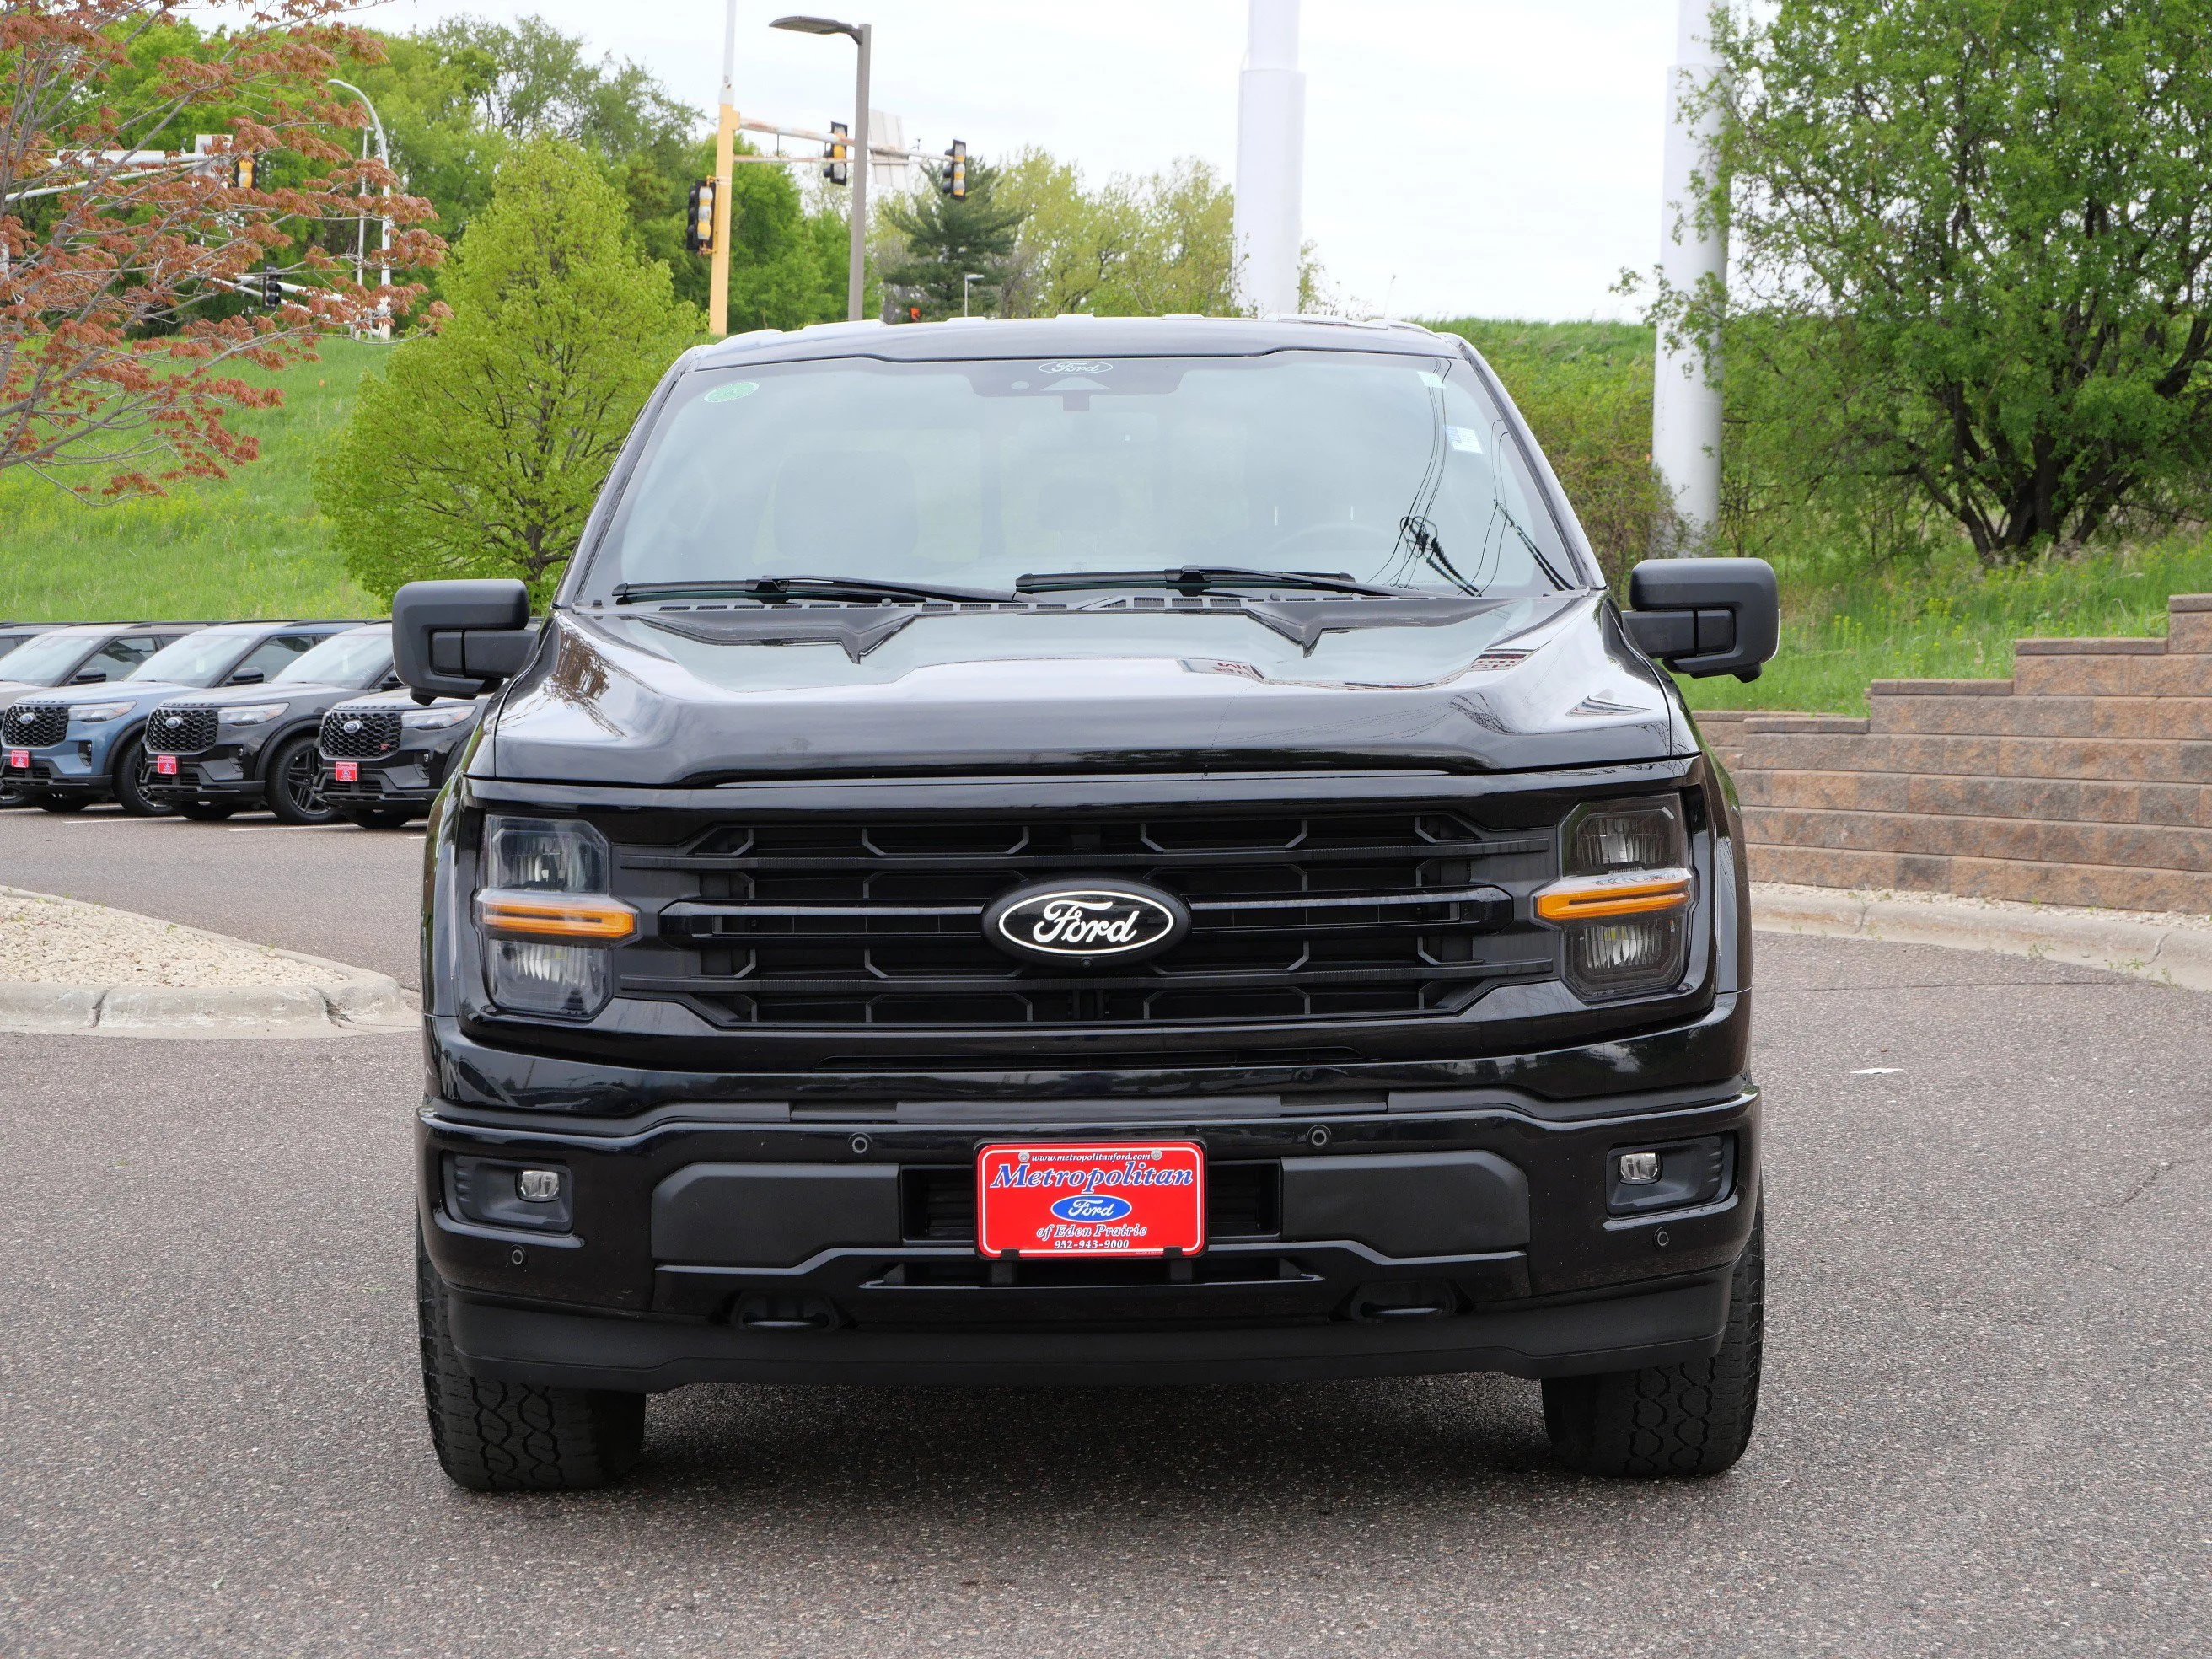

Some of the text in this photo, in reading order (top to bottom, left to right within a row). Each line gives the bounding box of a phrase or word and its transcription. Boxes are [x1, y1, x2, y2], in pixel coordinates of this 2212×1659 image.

[1051, 362, 1099, 373] Ford
[1033, 899, 1139, 942] Ford
[1031, 1152, 1151, 1162] www.metropolitanford.com
[990, 1161, 1193, 1194] Metropolitan
[1068, 1199, 1114, 1216] Ford
[1036, 1223, 1147, 1241] of Eden Prairie
[1055, 1239, 1129, 1248] 952-943-9000
